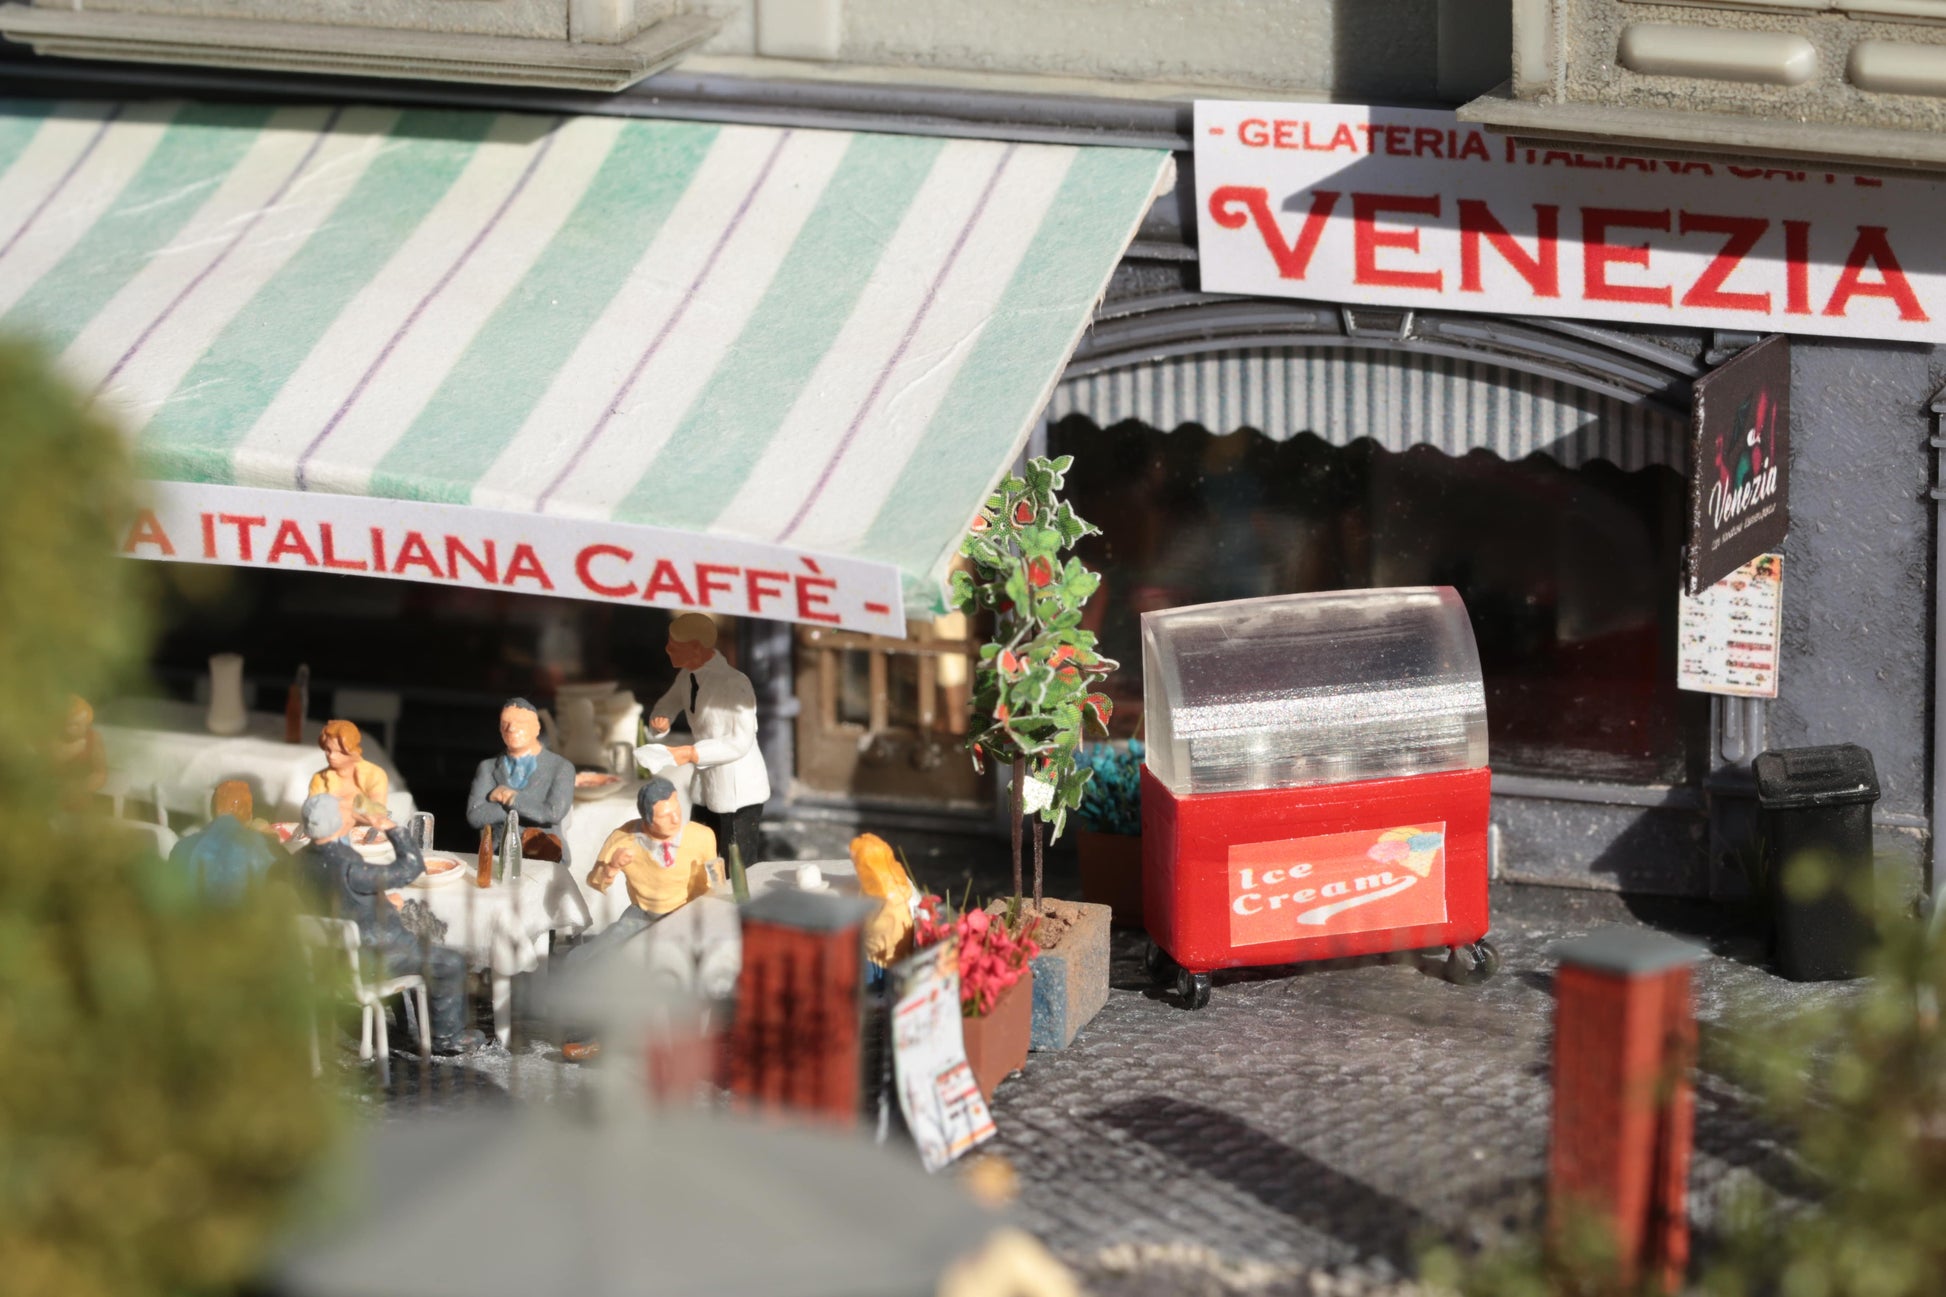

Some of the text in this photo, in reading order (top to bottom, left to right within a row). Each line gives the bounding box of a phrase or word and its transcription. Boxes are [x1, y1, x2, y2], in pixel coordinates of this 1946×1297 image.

[1237, 117, 1491, 162] GELATERIA
[1208, 184, 1931, 323] VENEZIA
[1708, 456, 1778, 531] Venezia
[200, 511, 555, 591] ITALIANA
[575, 543, 843, 625] CAFFÈ
[1232, 870, 1396, 916] Cream
[1238, 862, 1314, 890] Ice
